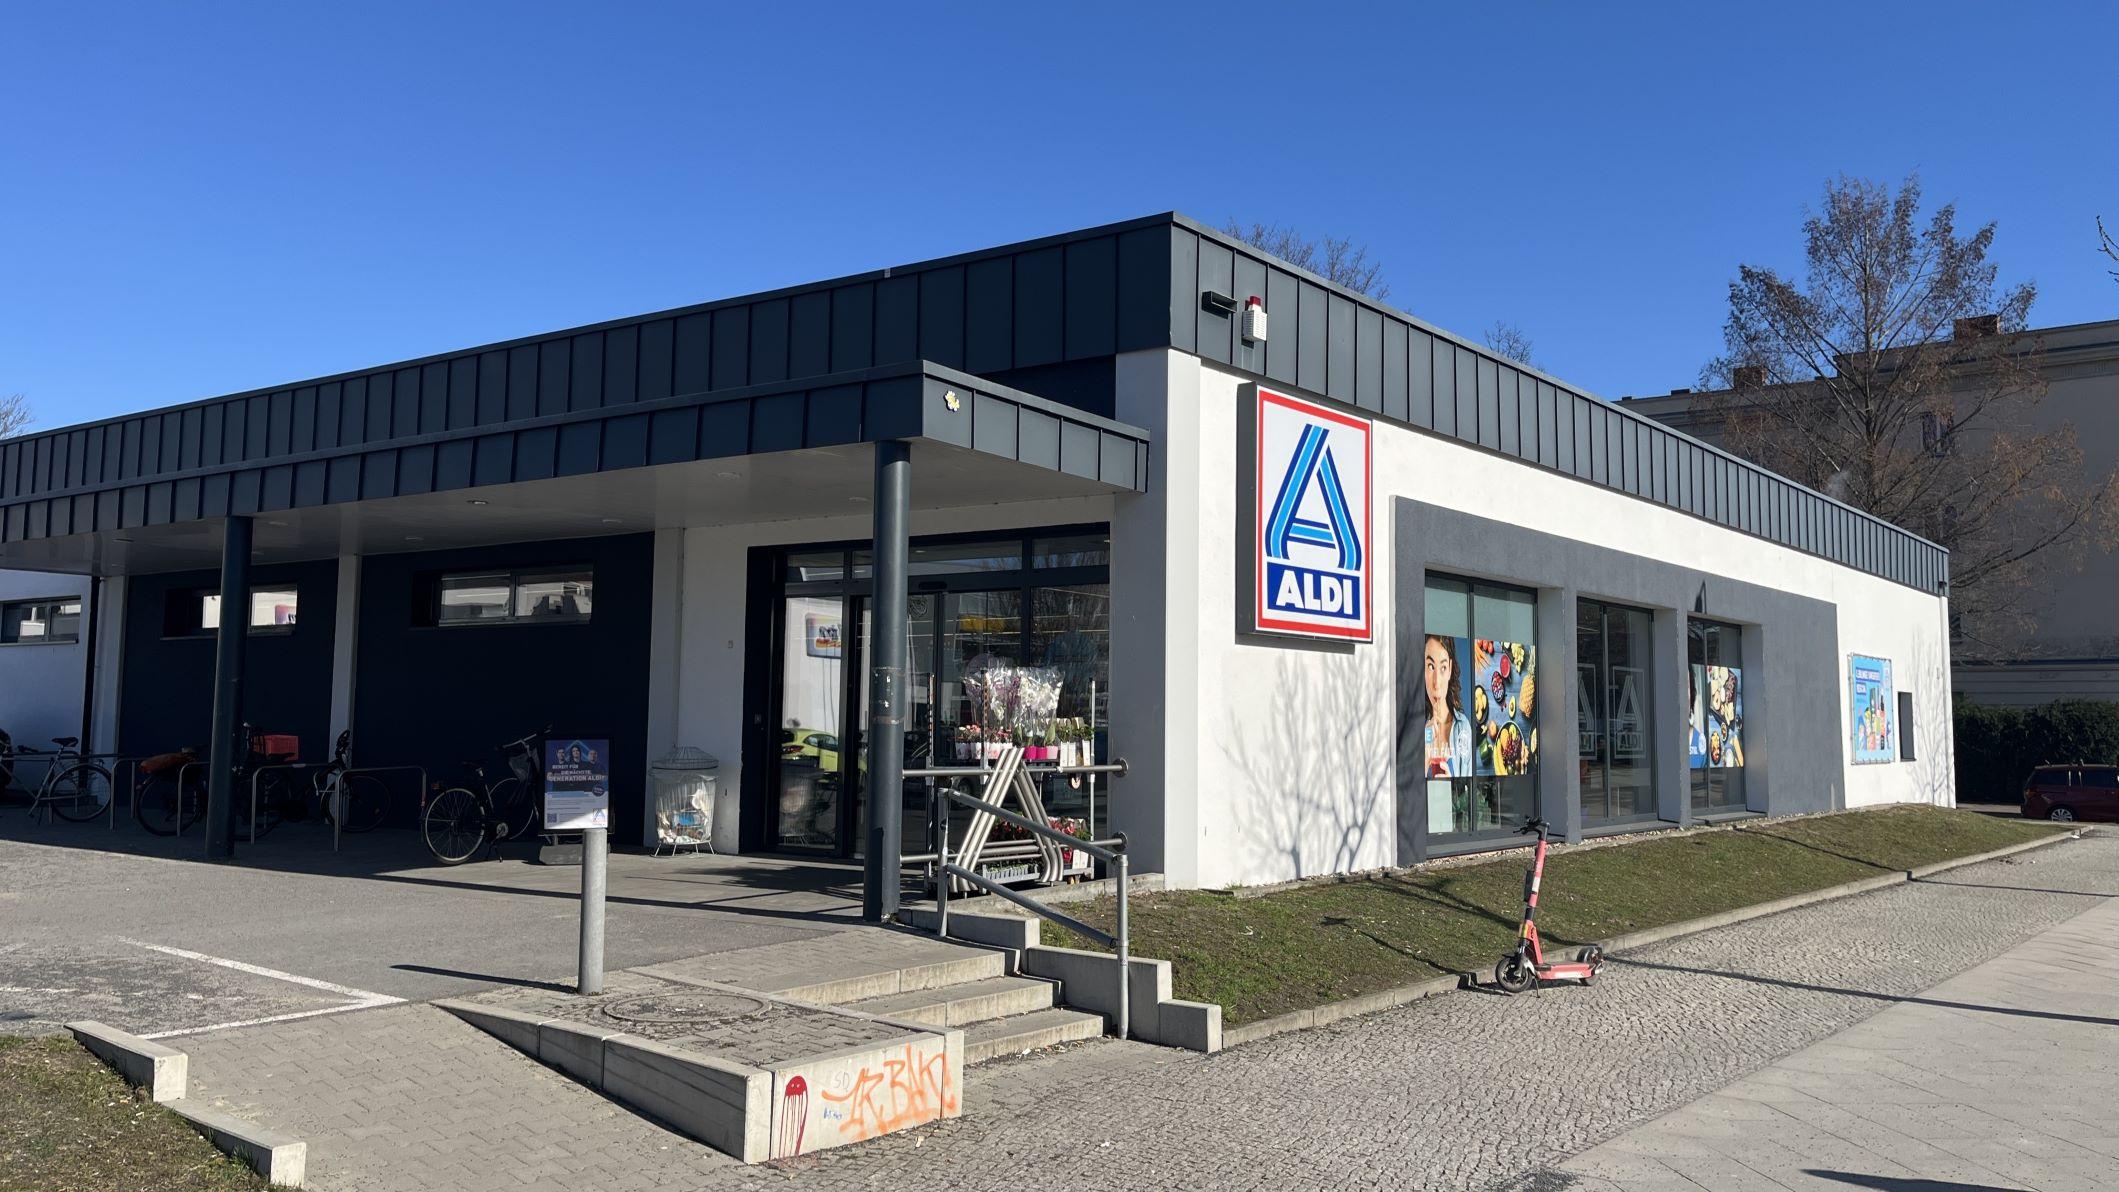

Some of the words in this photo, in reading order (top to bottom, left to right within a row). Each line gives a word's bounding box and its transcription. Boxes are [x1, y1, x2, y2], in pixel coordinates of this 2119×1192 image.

[1276, 569, 1353, 616] ALDI
[1619, 733, 1642, 750] ALDI
[548, 774, 587, 782] GENERATION
